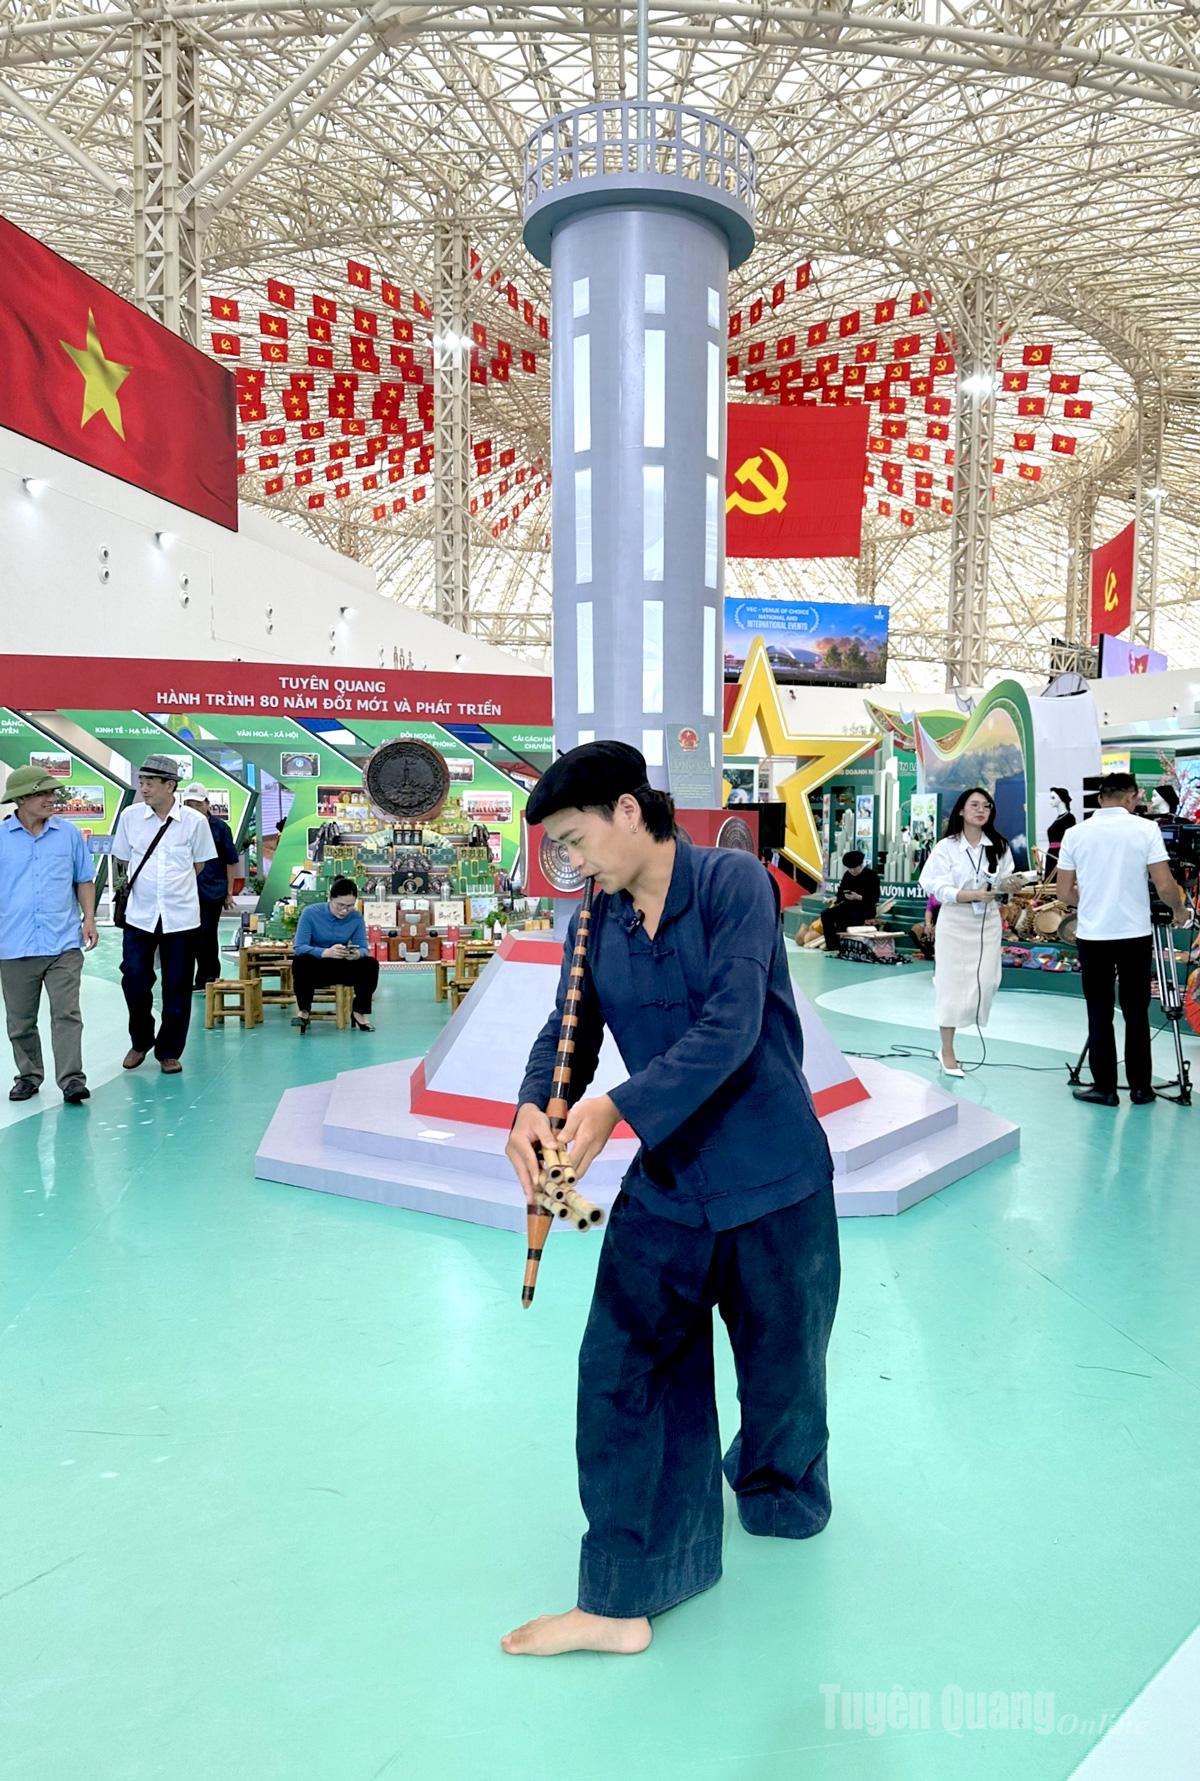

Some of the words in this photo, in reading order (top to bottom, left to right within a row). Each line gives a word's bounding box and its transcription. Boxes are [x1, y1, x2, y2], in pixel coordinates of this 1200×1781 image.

[747, 619, 787, 630] INTERNATIONAL
[787, 622, 808, 631] EVENTS
[279, 675, 330, 691] TUYÊN
[333, 679, 386, 694] QUANG
[156, 689, 200, 705] HÀNH
[205, 691, 255, 707] TRÌNH
[259, 695, 279, 708] 80
[283, 694, 318, 710] NĂM
[323, 693, 353, 711] ĐỔI
[356, 696, 388, 712] MỚI
[393, 698, 411, 713] VÀ
[416, 700, 452, 714] PHÁT
[457, 699, 502, 716] TRIỂN
[95, 726, 114, 734] KINH
[236, 729, 252, 737] VĂN
[907, 884, 930, 898] MÌN
